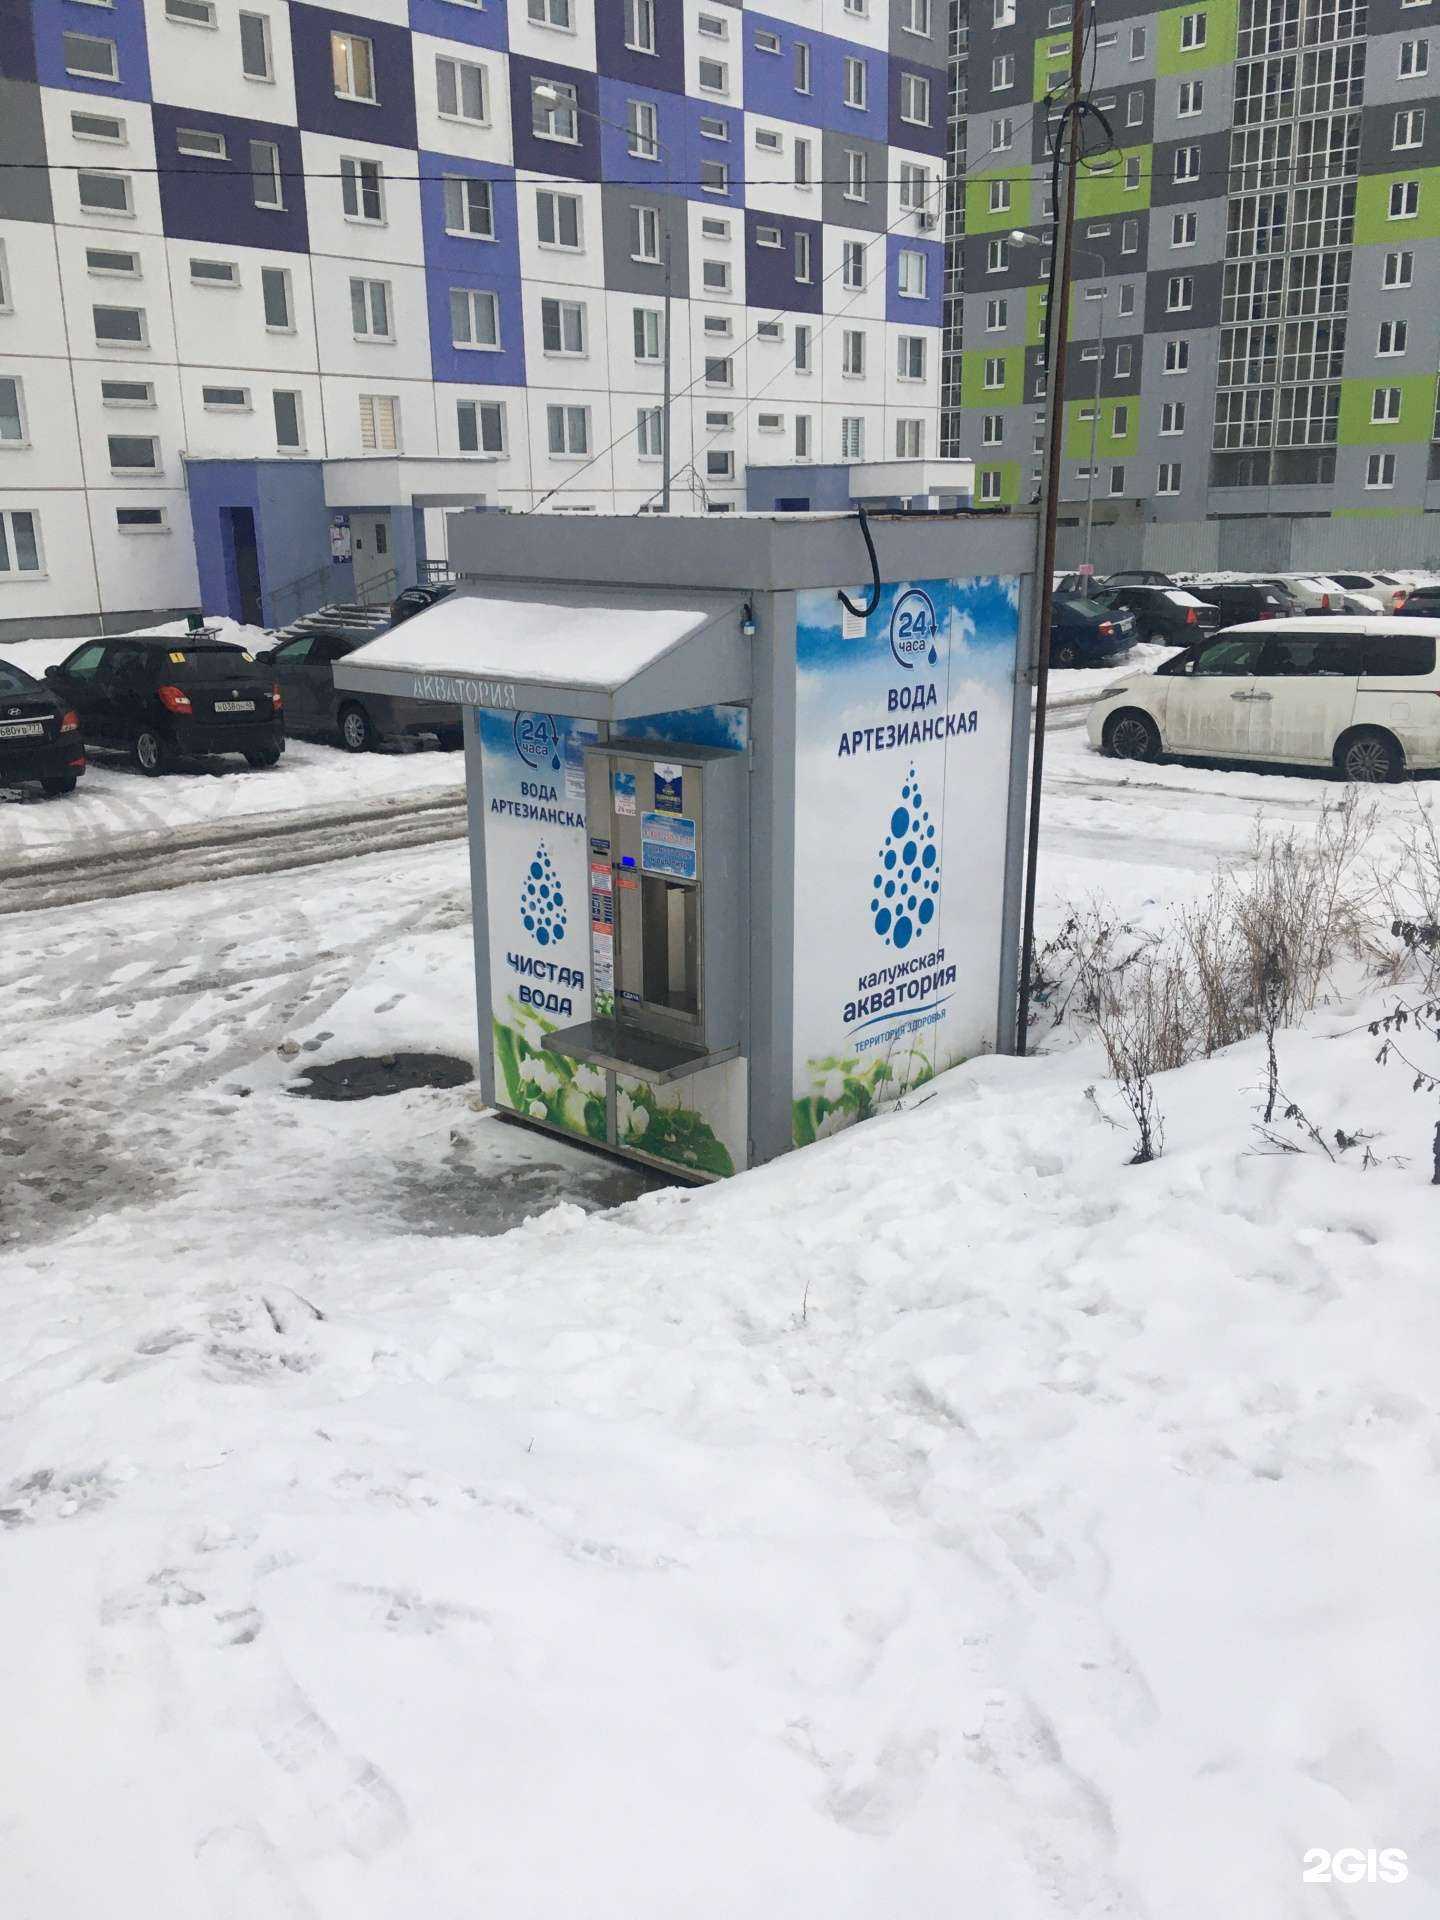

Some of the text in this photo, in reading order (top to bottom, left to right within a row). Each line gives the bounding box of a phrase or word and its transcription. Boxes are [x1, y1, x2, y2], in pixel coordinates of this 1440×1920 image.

[898, 611, 927, 638] 24
[898, 639, 926, 652] часа
[413, 676, 516, 706] АКВАТОРИЯ
[887, 683, 937, 712] ВОДА
[521, 719, 548, 742] 24
[838, 710, 978, 757] АРТЕЗИАНСКАЯ
[522, 742, 549, 756] часа
[521, 782, 557, 801] ВОДА
[507, 951, 585, 990] ЧИСТАЯ
[858, 948, 945, 992] калужская
[519, 985, 573, 1017] ВОДА
[843, 965, 956, 1023] акватория
[855, 1008, 946, 1053] ТЕРРИТОРИЯ ЗДОРОВЬЯ
